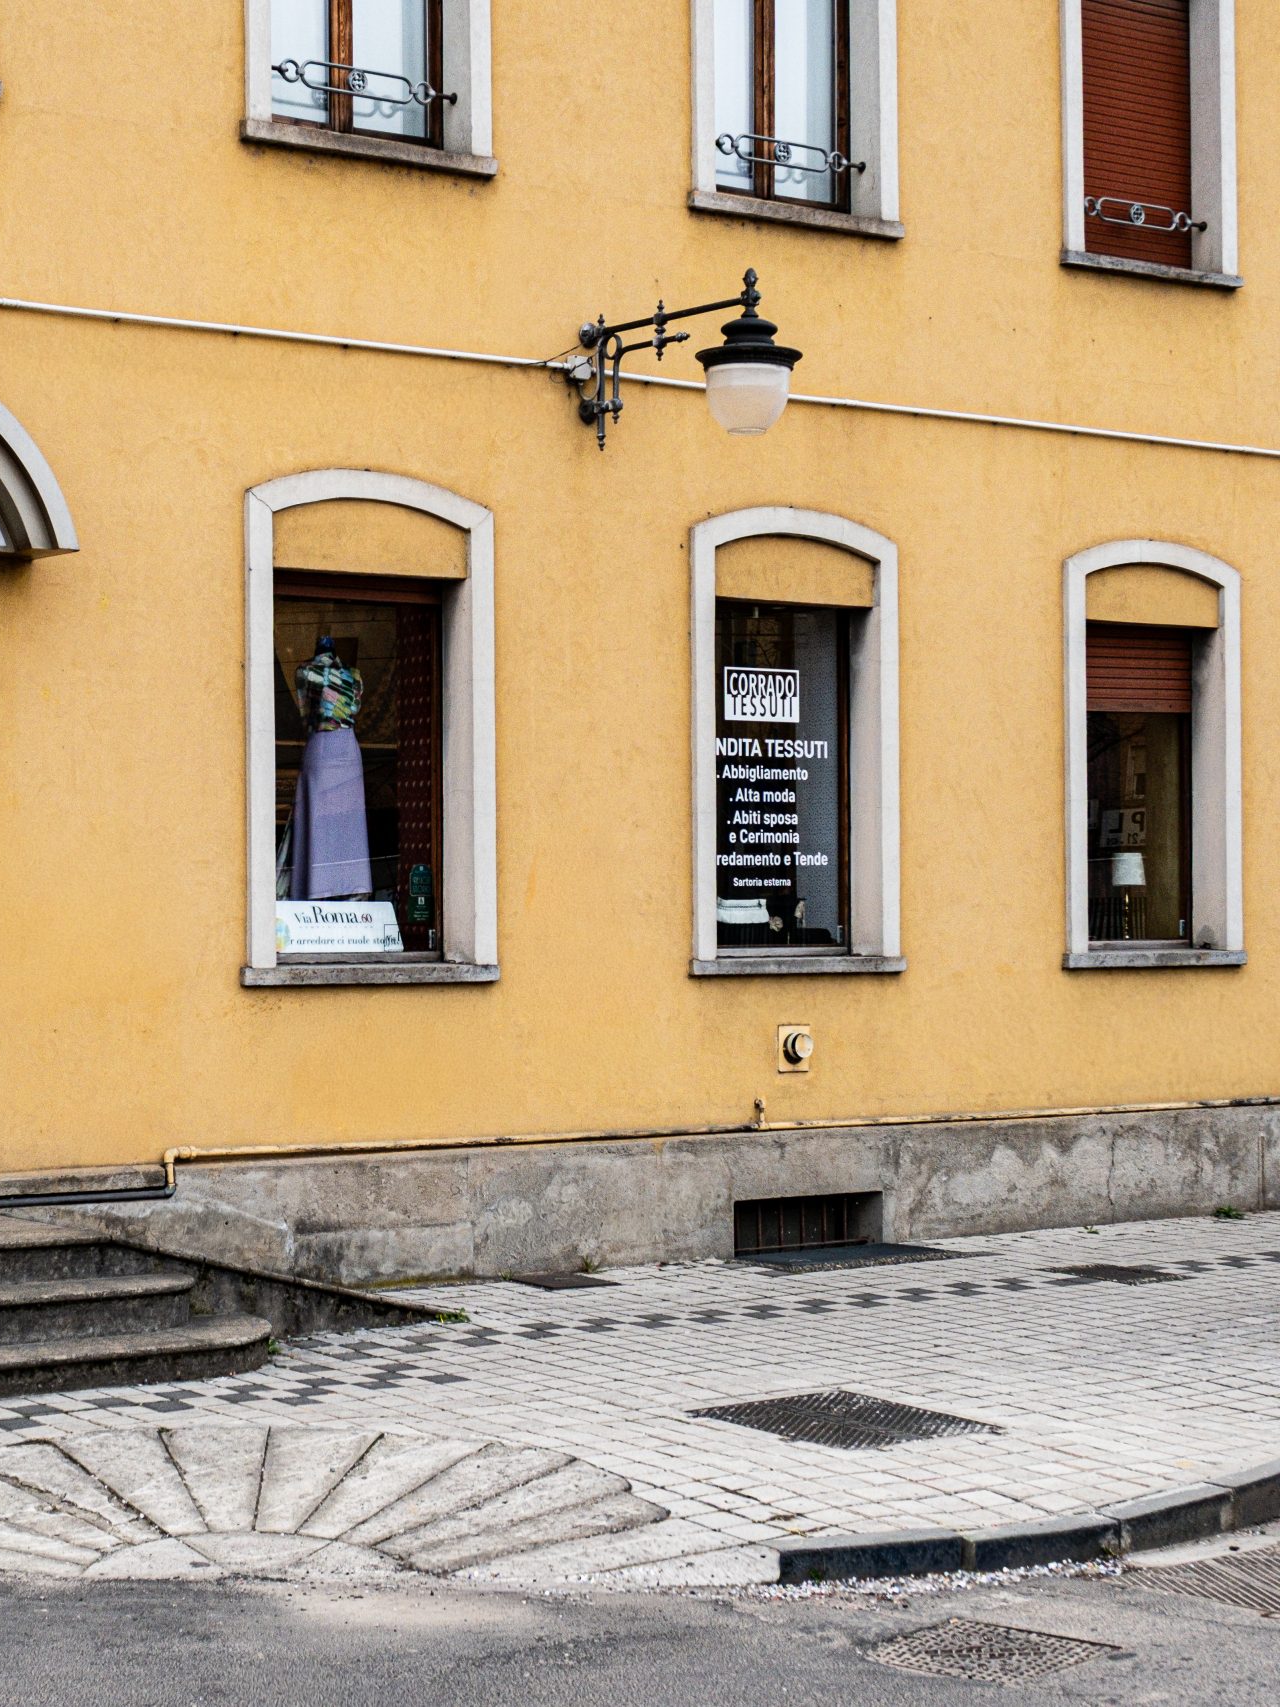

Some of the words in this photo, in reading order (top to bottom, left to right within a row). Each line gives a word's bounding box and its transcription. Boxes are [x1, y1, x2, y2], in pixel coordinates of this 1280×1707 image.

[729, 672, 795, 697] CORRADO
[731, 695, 794, 717] TESSUTI
[765, 739, 828, 759] TESSUTI
[723, 764, 808, 782] Abbigliamento
[735, 788, 760, 803] Alta
[762, 788, 796, 803] moda
[732, 810, 761, 825] Abiti
[763, 813, 799, 827] sposa
[729, 831, 737, 843] e
[739, 829, 800, 843] Cerimonia
[783, 854, 791, 866] e
[793, 852, 829, 866] Tende
[733, 877, 762, 887] Sartoria
[763, 878, 792, 887] esterna
[294, 912, 312, 923] Via
[296, 936, 335, 945] arredare
[337, 936, 345, 945] ci
